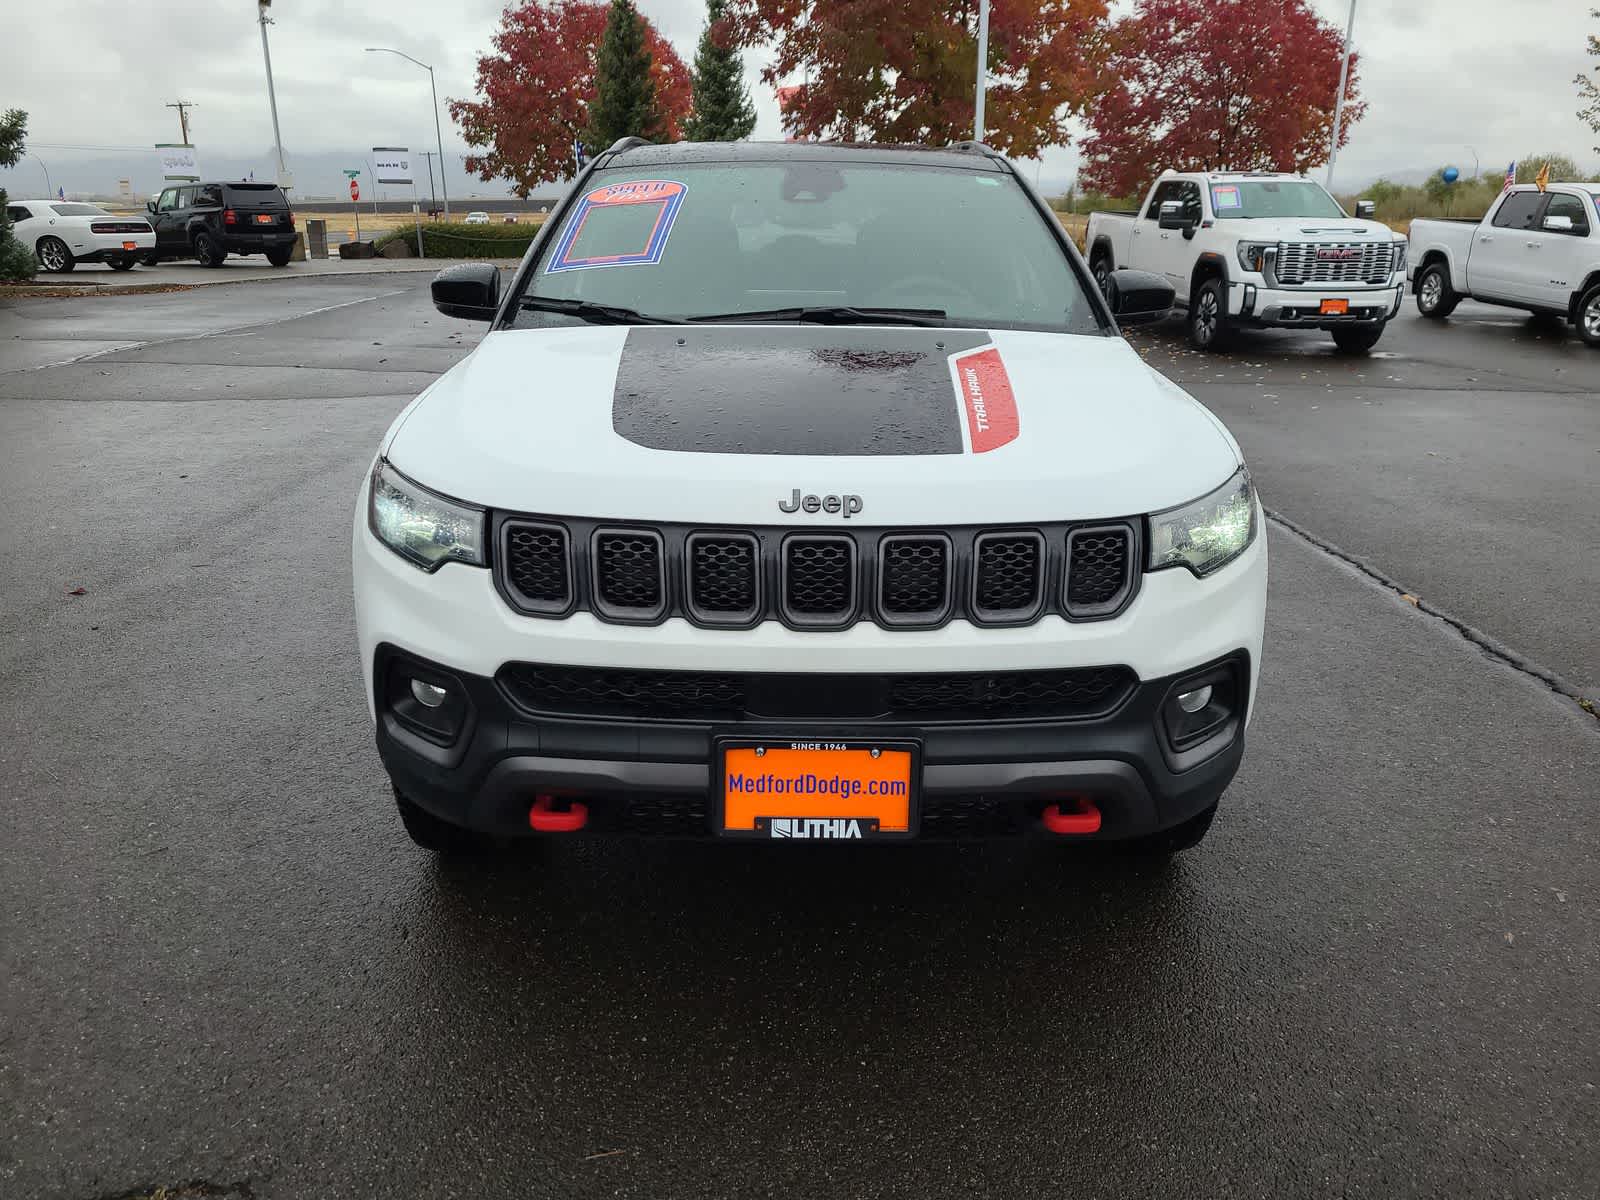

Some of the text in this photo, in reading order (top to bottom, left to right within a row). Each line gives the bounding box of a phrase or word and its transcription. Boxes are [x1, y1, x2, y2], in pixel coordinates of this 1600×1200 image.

[778, 488, 864, 518] Jeep
[791, 742, 847, 751] SINCE 1946
[729, 773, 906, 798] MedfordDodge.com
[791, 818, 862, 839] LITHIA
